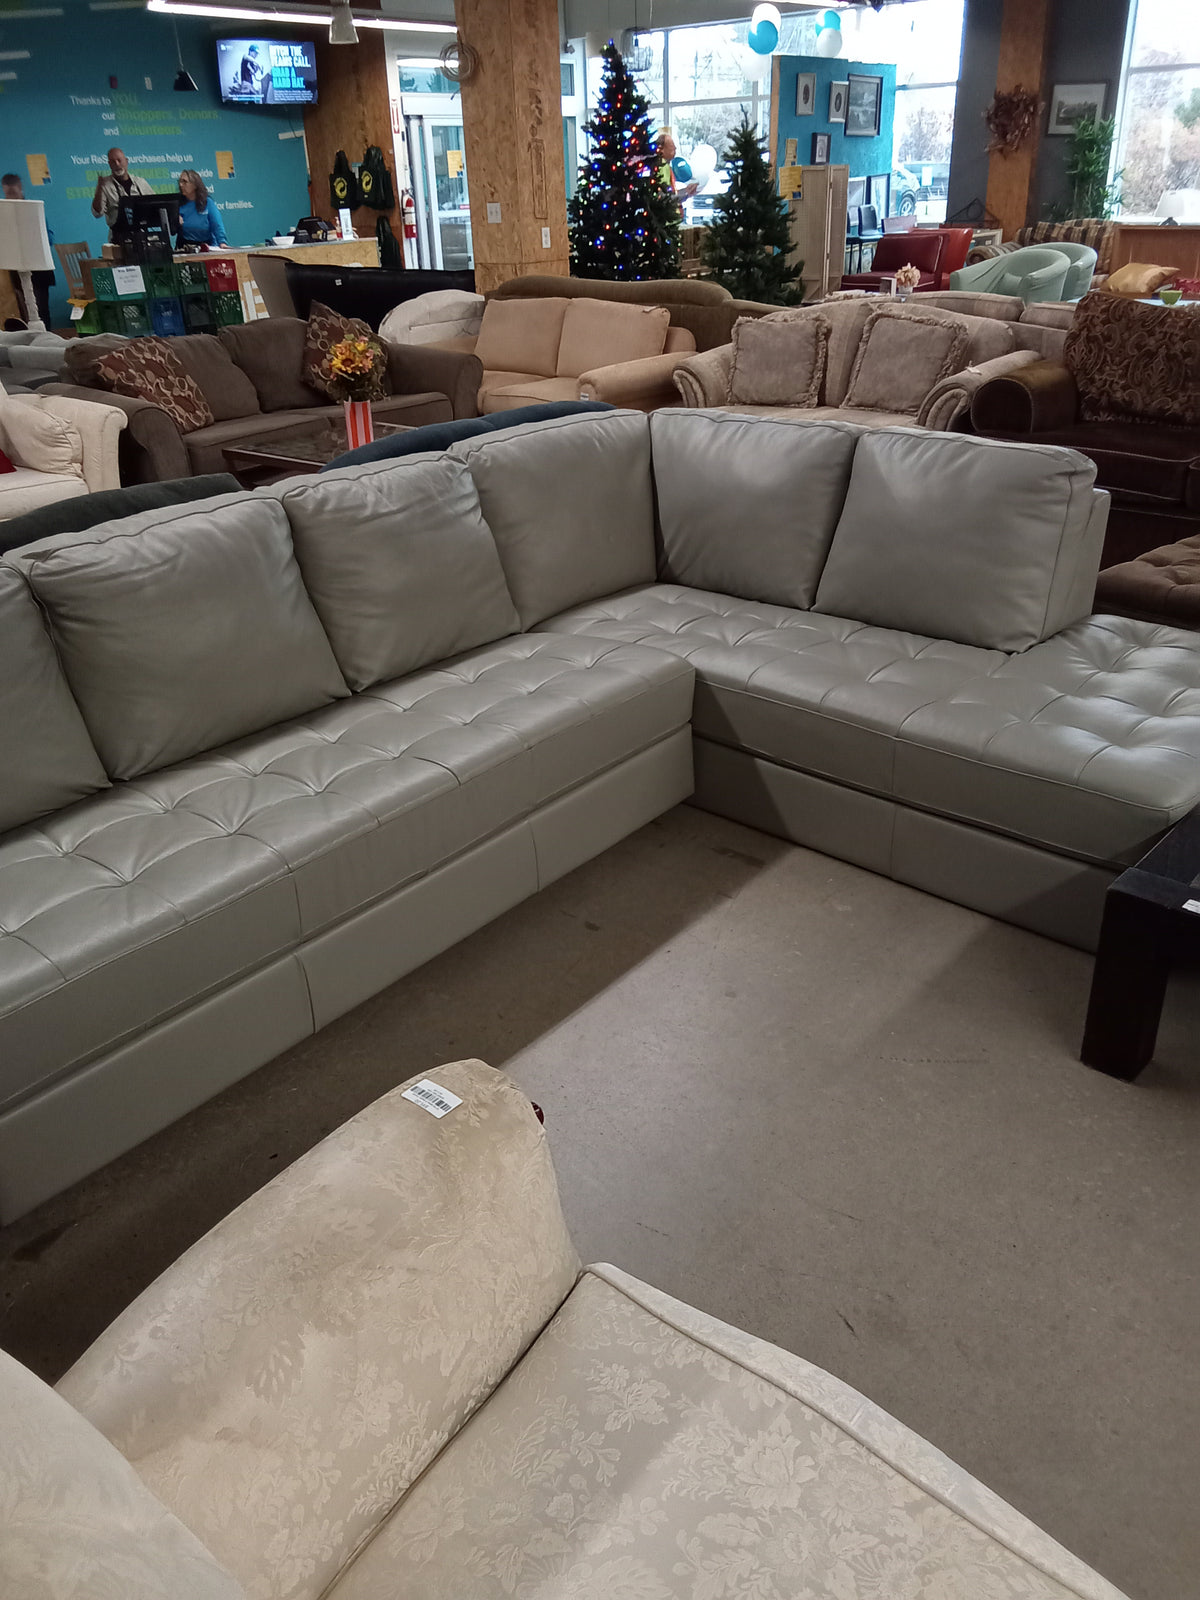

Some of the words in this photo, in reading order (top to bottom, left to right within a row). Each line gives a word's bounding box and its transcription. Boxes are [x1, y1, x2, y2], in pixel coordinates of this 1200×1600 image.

[70, 95, 100, 106] Thanks
[102, 96, 111, 105] to
[102, 112, 116, 121] our
[104, 126, 119, 136] and
[71, 154, 90, 165] Your
[166, 153, 183, 164] help
[184, 154, 193, 162] us
